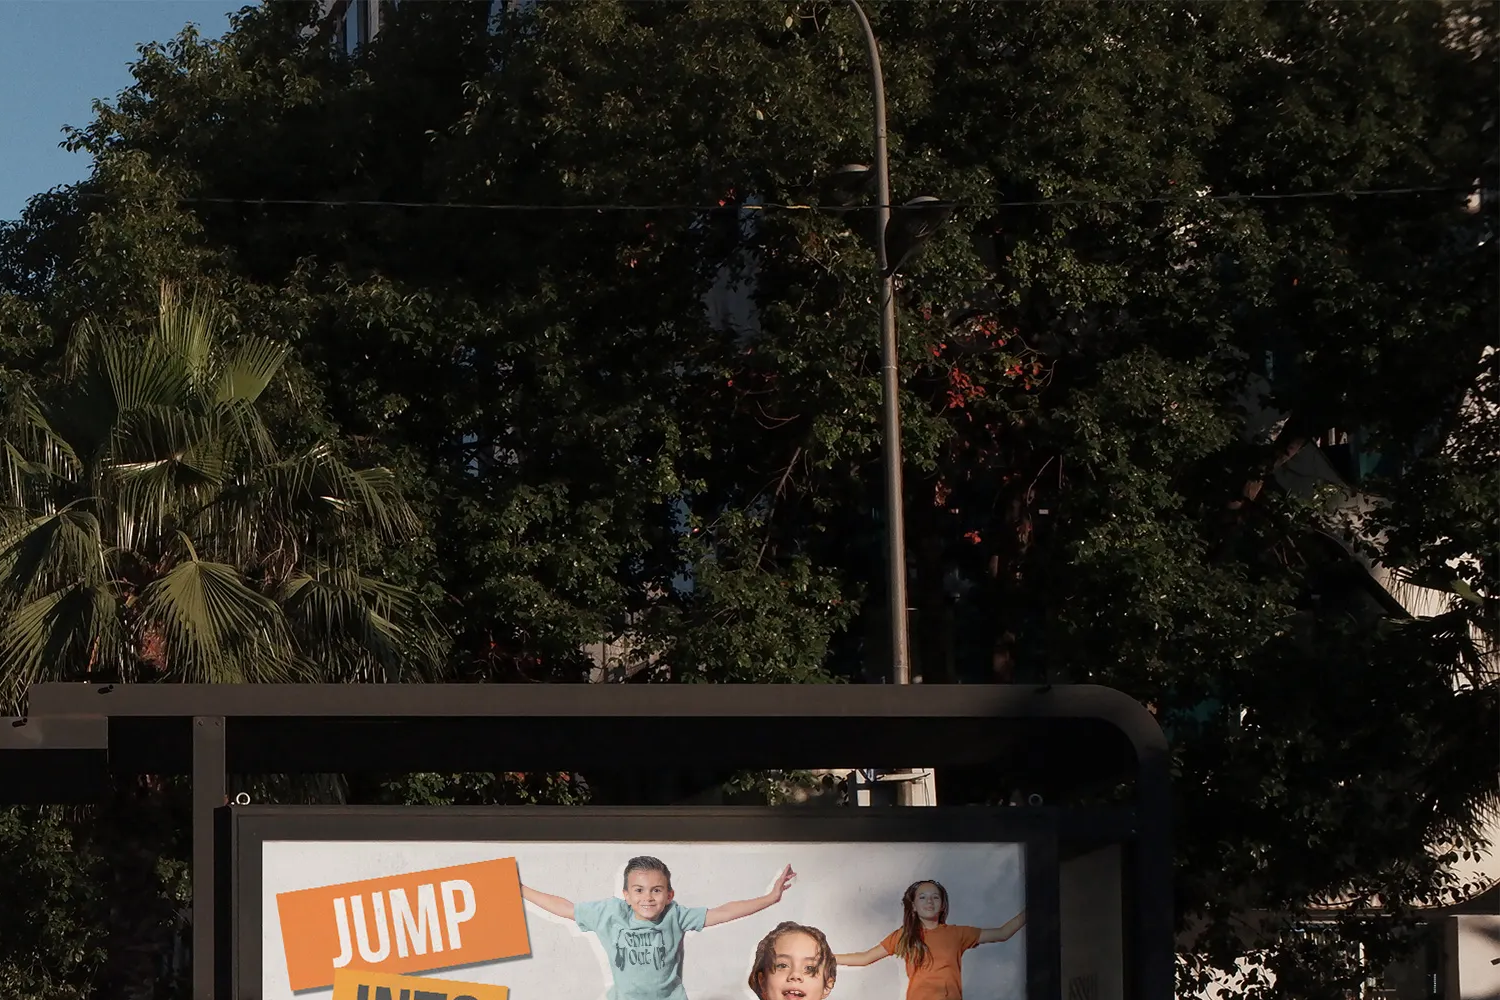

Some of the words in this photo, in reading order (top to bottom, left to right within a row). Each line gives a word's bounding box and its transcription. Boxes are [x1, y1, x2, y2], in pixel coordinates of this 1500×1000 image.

[332, 879, 477, 968] JUMP
[624, 931, 653, 947] Chill
[628, 948, 652, 965] Out
